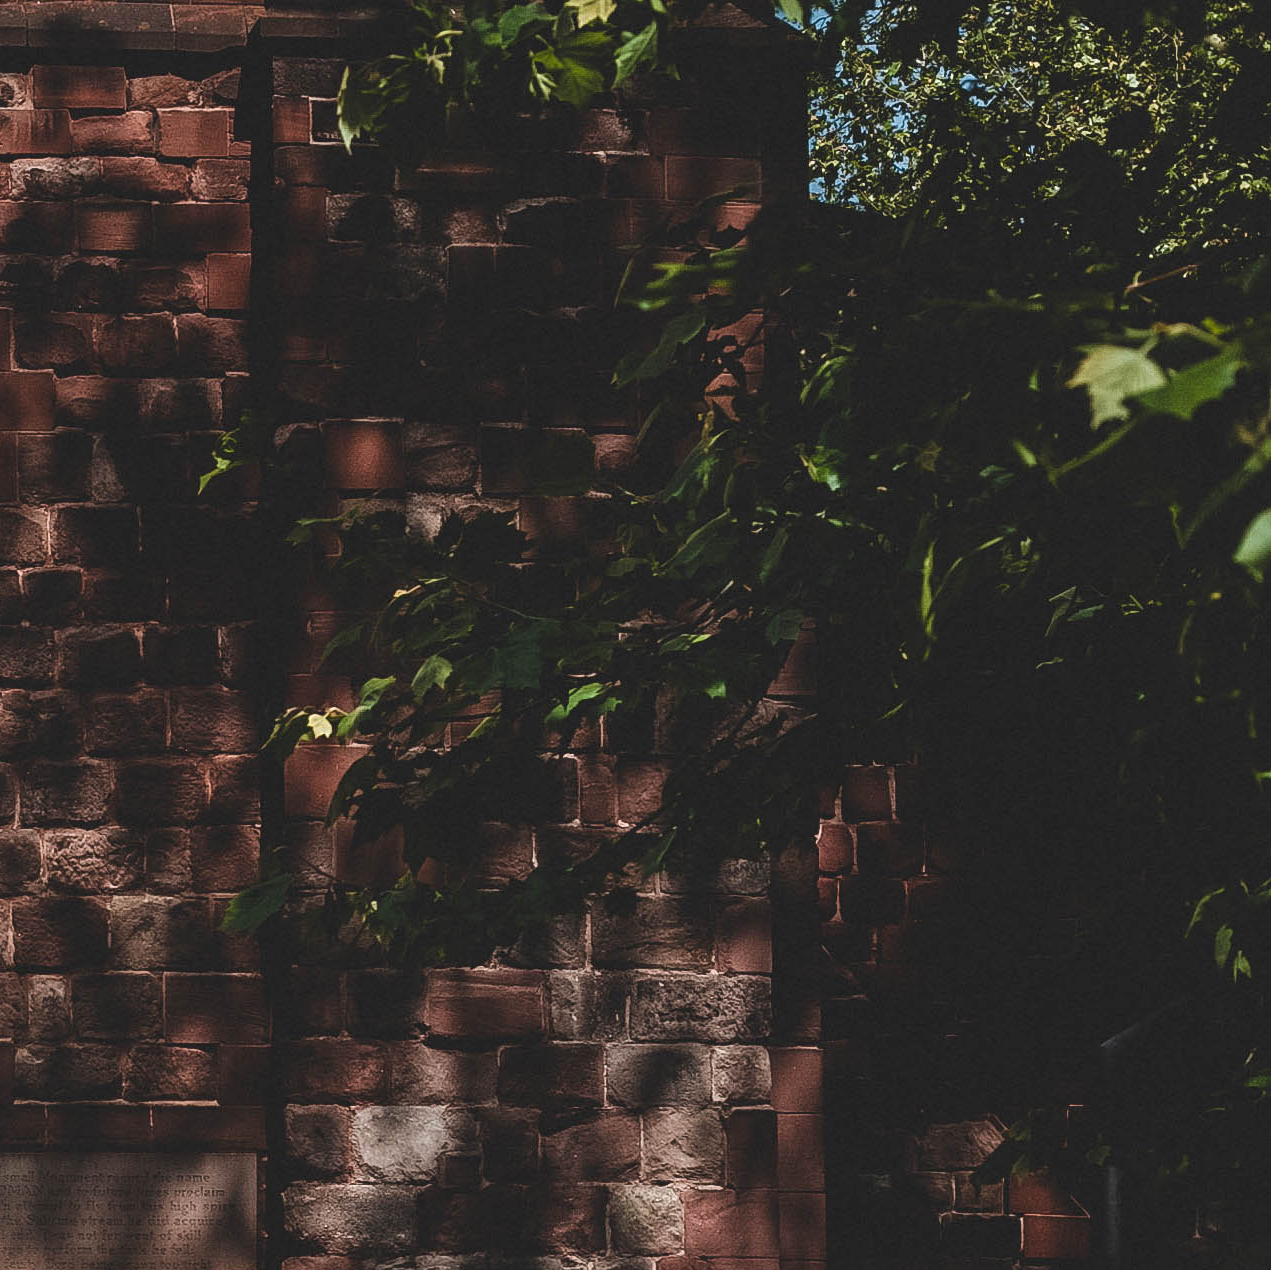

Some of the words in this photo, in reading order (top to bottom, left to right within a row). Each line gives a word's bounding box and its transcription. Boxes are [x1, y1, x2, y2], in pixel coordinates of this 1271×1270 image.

[3, 1171, 35, 1182] small
[176, 1173, 210, 1182] name
[174, 1186, 226, 1198] proclaim
[170, 1201, 197, 1215] high
[174, 1217, 223, 1228] acquire
[177, 1230, 203, 1241] skill
